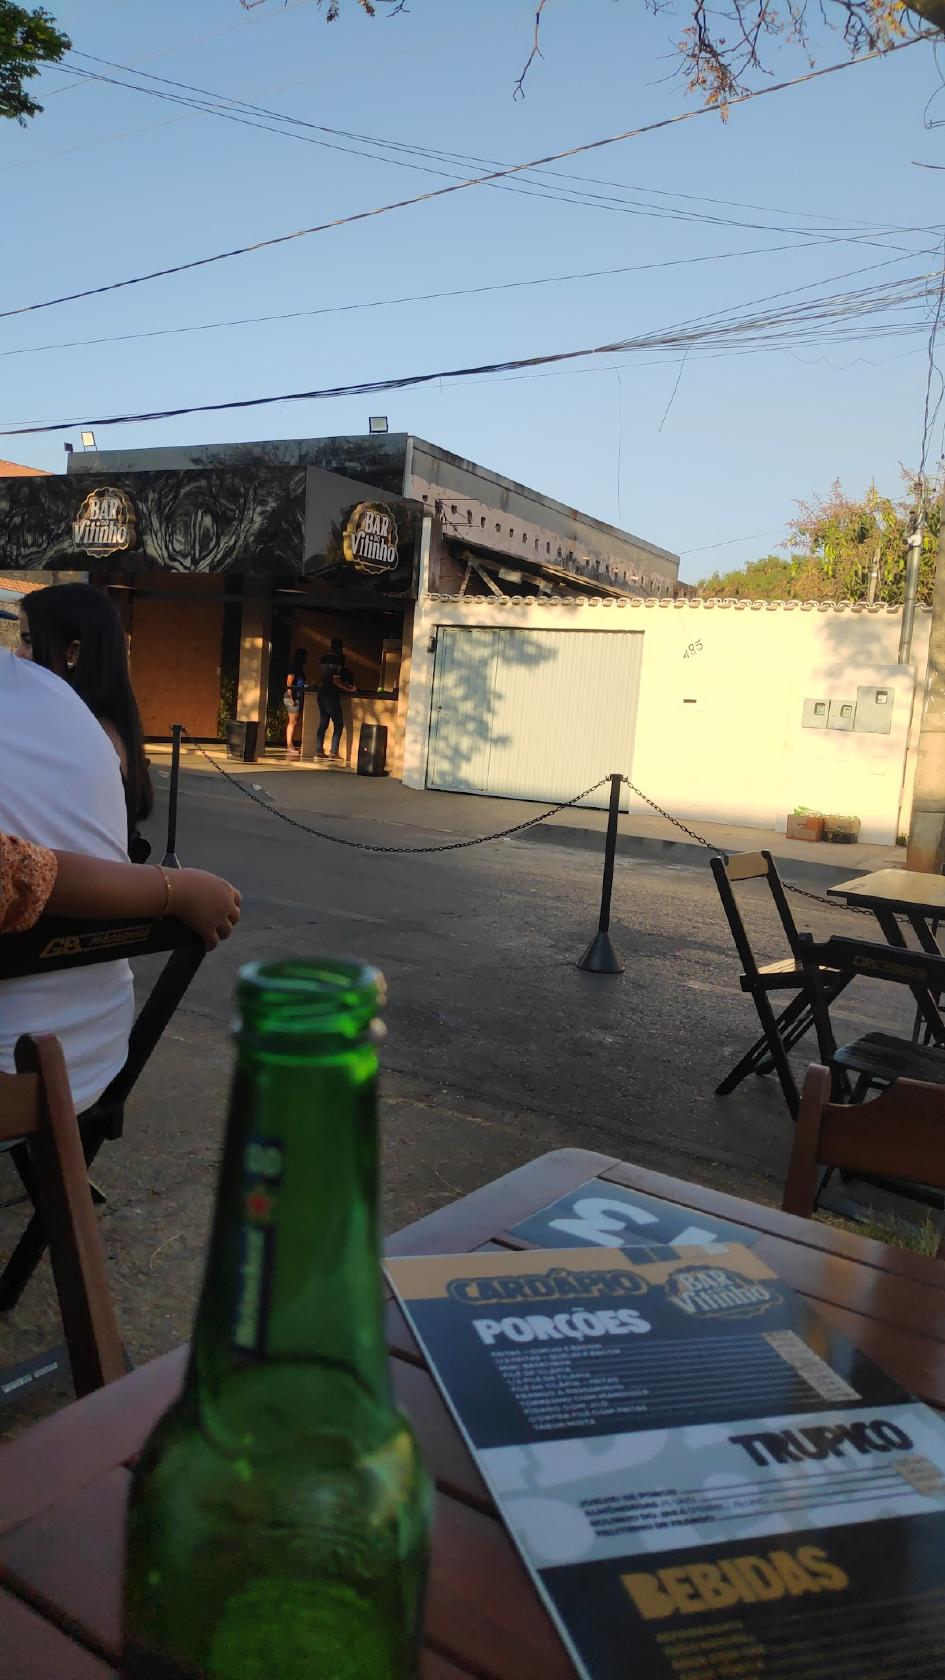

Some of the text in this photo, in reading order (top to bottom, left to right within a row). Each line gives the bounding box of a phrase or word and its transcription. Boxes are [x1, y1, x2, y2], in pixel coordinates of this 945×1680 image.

[90, 499, 118, 519] BAR
[365, 512, 389, 537] BAR
[74, 520, 127, 543] Vitinho
[351, 531, 395, 562] Vitinho
[683, 638, 703, 659] 485
[453, 1269, 646, 1302] CARDÁPIO
[680, 1268, 734, 1290] BAR
[676, 1283, 770, 1314] Vitinho
[472, 1307, 653, 1345] PORÇÕES
[728, 1419, 914, 1467] TRUPICO
[620, 1545, 849, 1621] BEBIDAS
